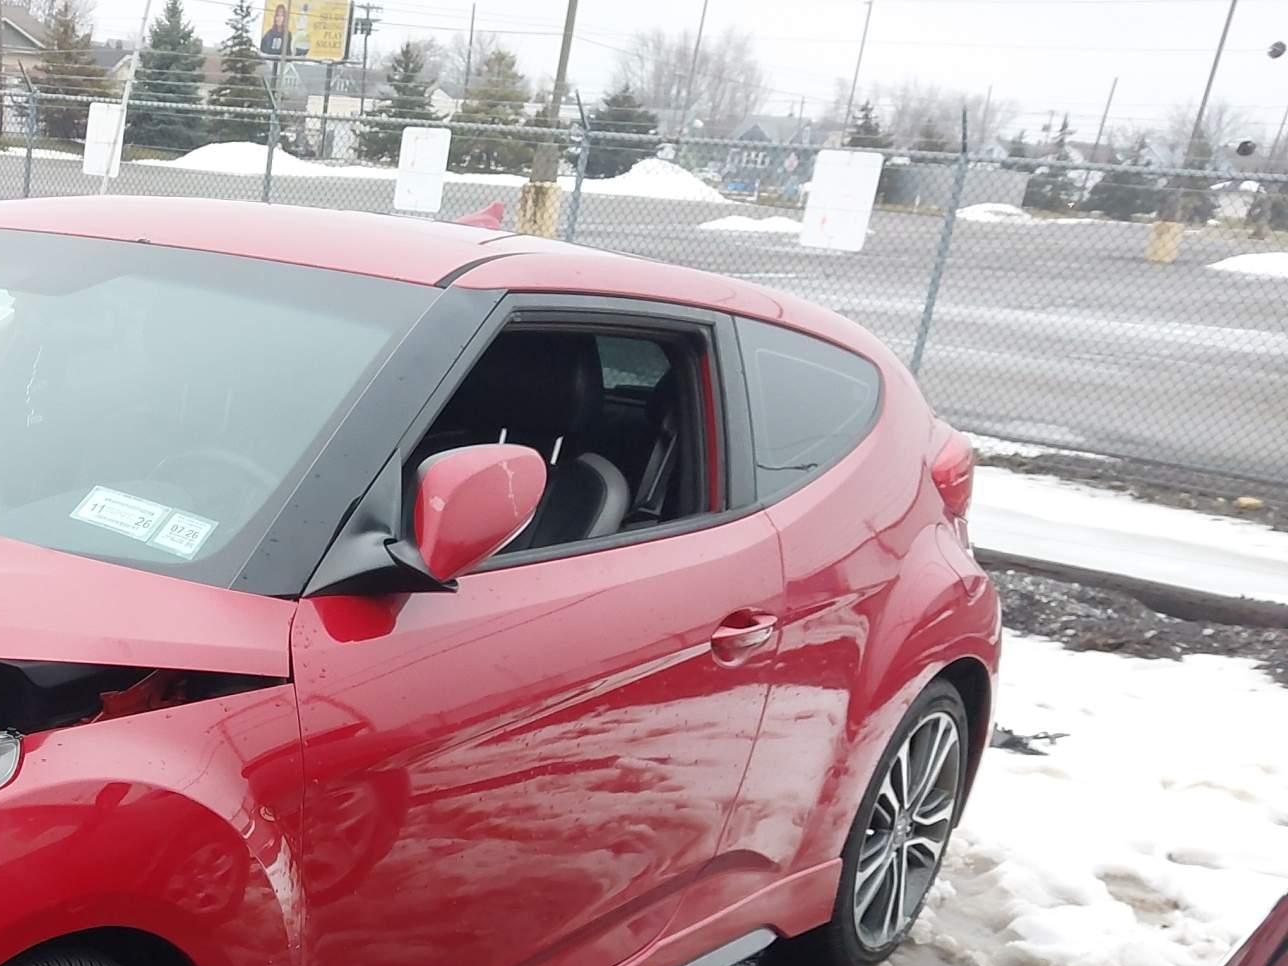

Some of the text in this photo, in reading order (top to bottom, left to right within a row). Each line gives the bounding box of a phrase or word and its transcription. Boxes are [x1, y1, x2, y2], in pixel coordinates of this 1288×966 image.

[90, 503, 106, 513] 11
[134, 516, 153, 529] 26
[170, 523, 185, 535] 07
[185, 529, 200, 540] 26
